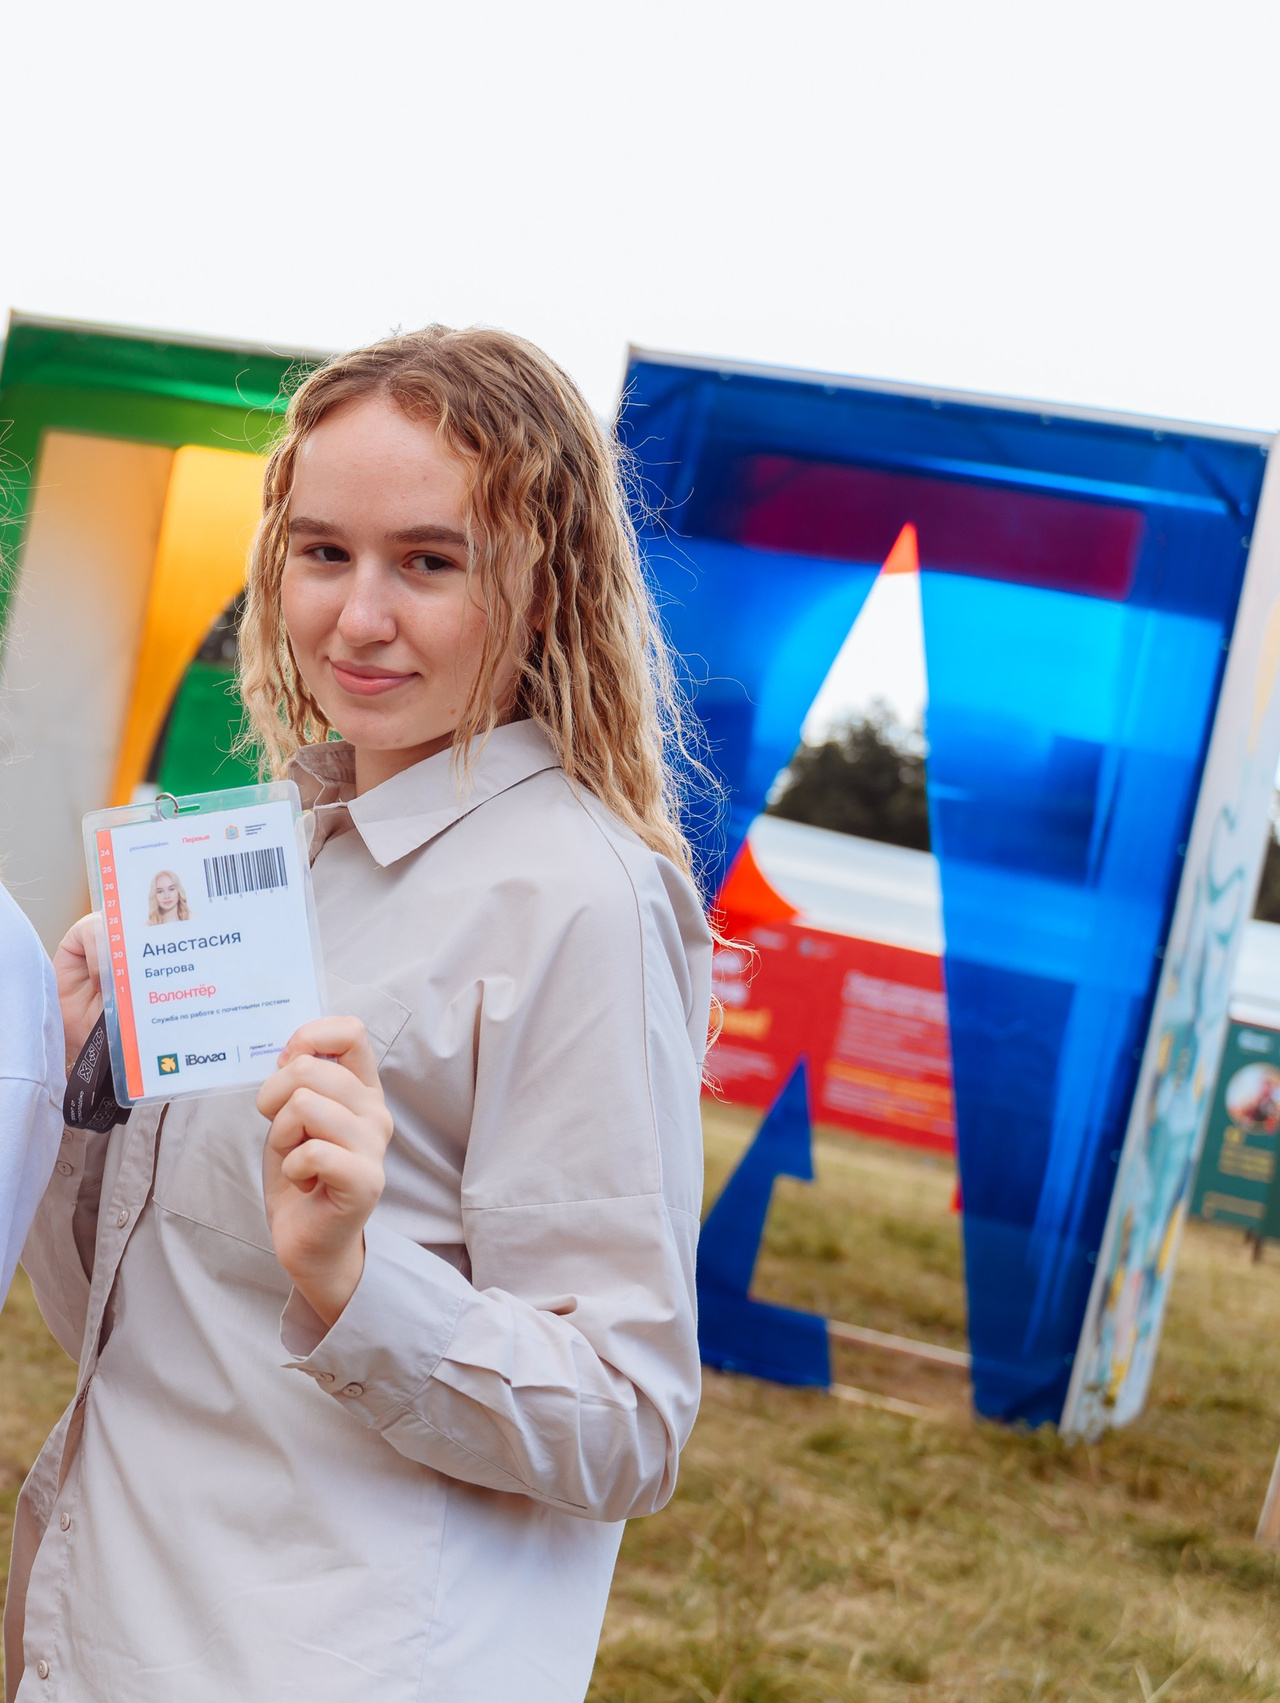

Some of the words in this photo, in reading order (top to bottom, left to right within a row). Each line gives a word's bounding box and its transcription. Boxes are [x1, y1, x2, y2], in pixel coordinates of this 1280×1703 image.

[100, 849, 110, 857] 24
[102, 865, 112, 874] 25
[104, 882, 115, 891] 26
[107, 899, 116, 908] 27
[108, 917, 119, 925] 28
[111, 934, 121, 942] 29
[142, 931, 242, 958] Анастасия
[112, 951, 123, 959] 30
[116, 968, 124, 976] 31
[144, 963, 195, 979] Багрова
[148, 984, 217, 1004] Волонтёр
[151, 1014, 179, 1024] Служба
[190, 1010, 215, 1020] работе
[221, 1003, 260, 1013] почетными
[261, 998, 290, 1007] гостями
[185, 1052, 227, 1066] iВолга
